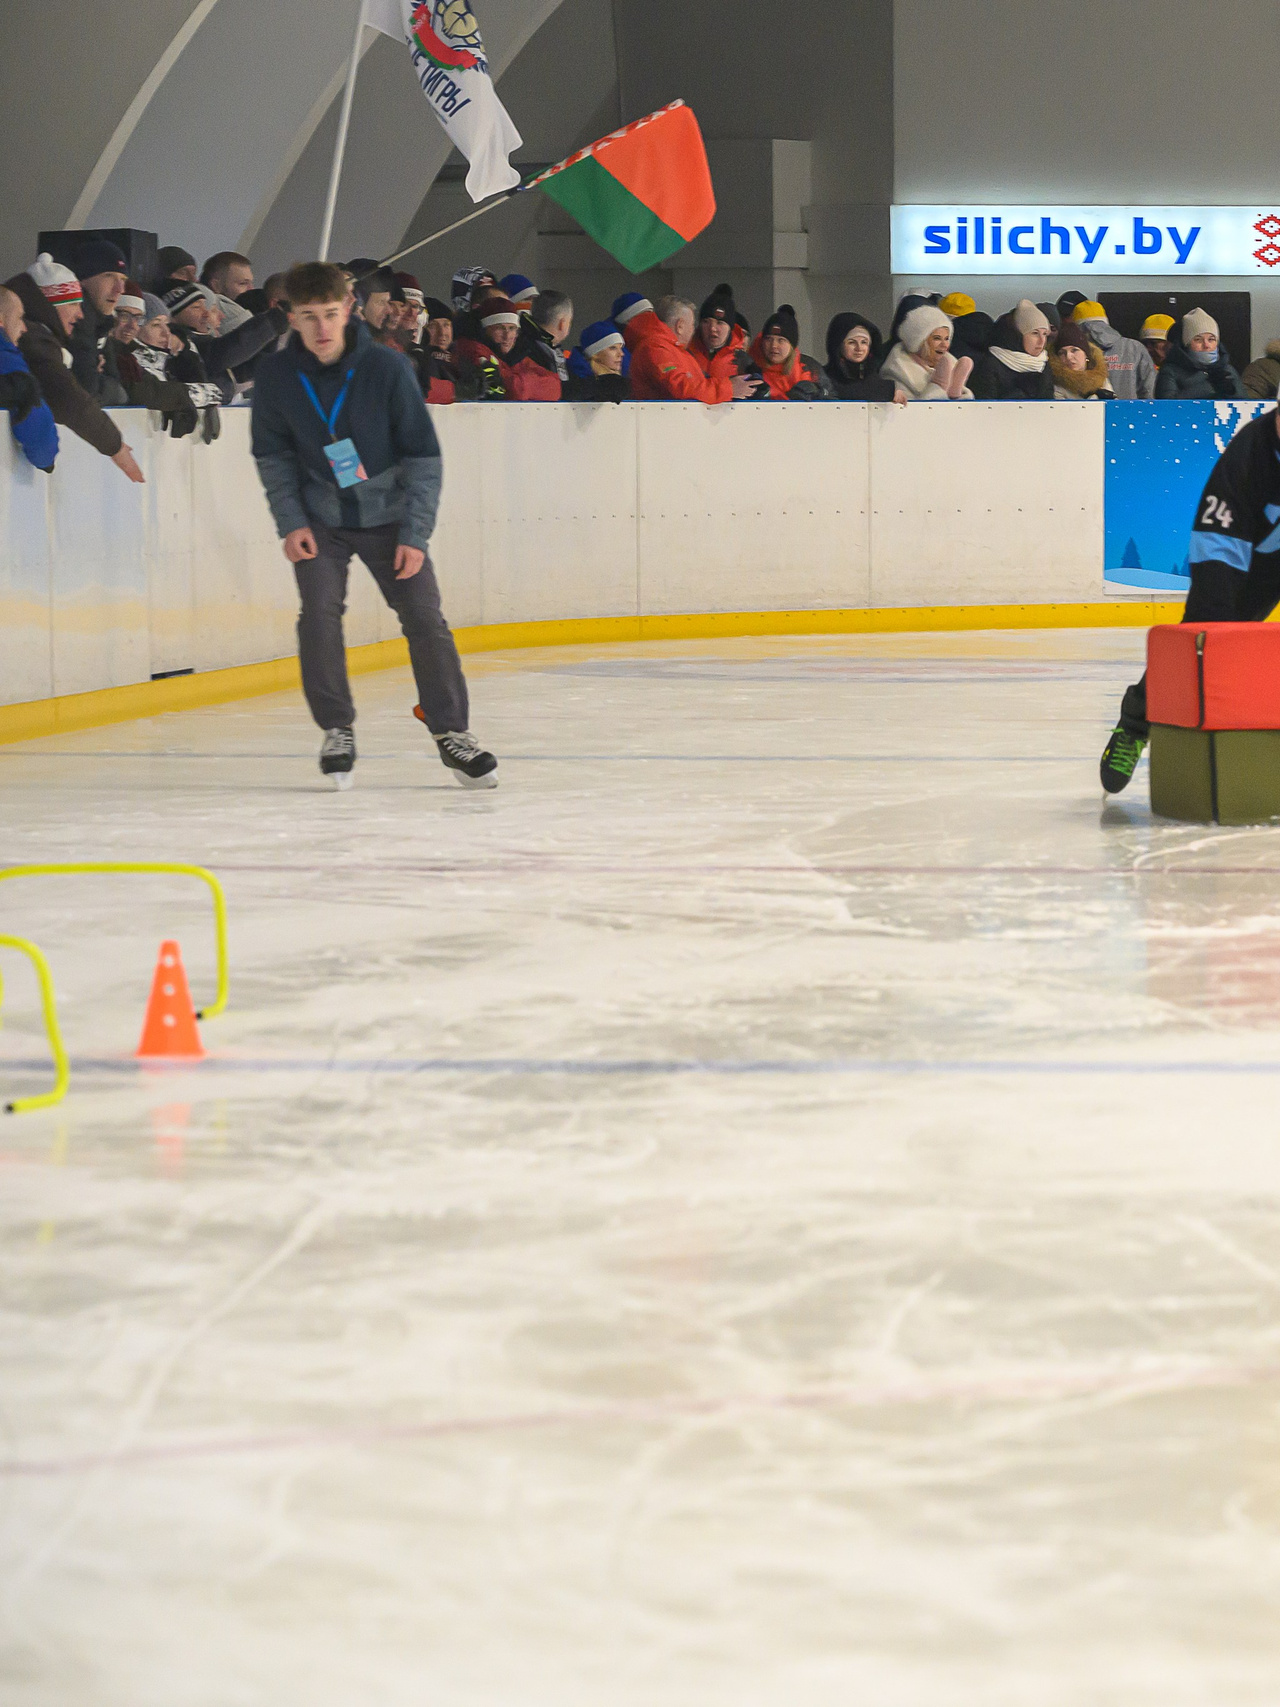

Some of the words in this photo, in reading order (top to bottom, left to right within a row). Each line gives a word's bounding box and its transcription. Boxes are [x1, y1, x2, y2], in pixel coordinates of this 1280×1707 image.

[421, 60, 471, 118] ТИГРЫ
[924, 217, 1201, 264] silichy.by
[1202, 495, 1233, 528] 24
